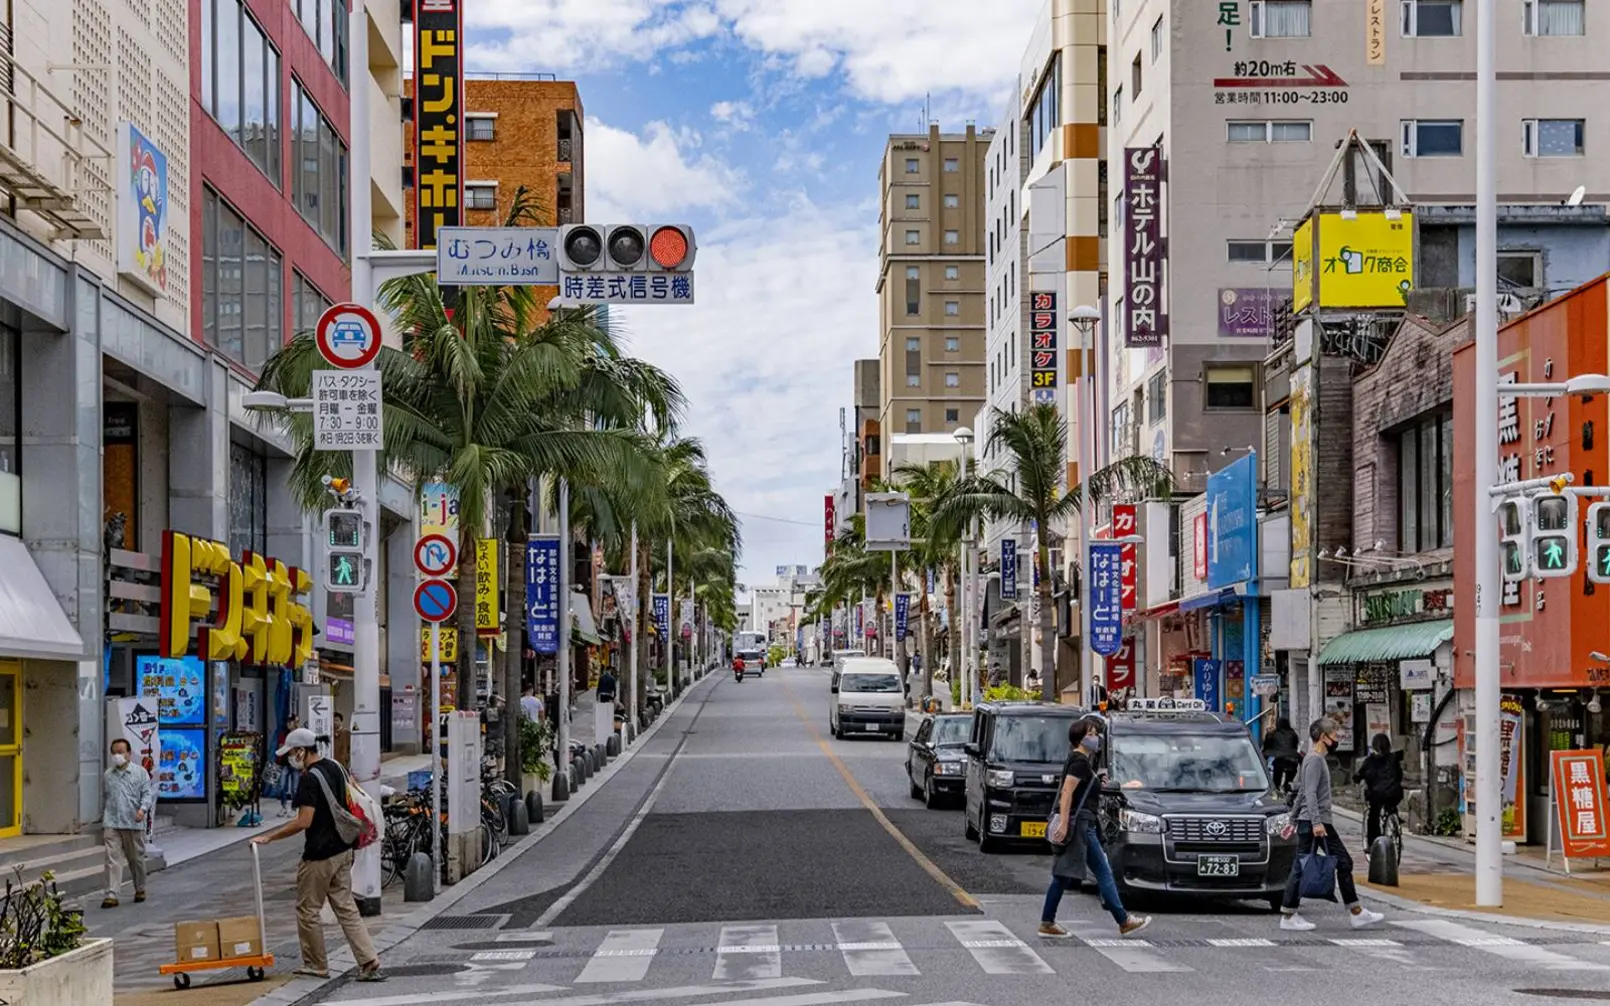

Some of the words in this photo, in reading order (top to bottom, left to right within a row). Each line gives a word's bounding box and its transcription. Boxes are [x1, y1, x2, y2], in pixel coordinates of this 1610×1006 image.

[1234, 60, 1296, 77] 約20m右
[1214, 92, 1261, 104] 営業時間
[448, 238, 550, 260] むつみ橋
[1131, 184, 1155, 331] ホテル山の内
[565, 276, 690, 299] 時差式信号機
[1035, 293, 1052, 367] カラオケ
[1033, 372, 1054, 386] 3F
[319, 389, 377, 401] 許可車を除く
[319, 403, 339, 415] 月曜
[357, 403, 377, 415] 金曜
[320, 416, 342, 429] 7:30
[356, 416, 378, 429] 9:00
[528, 547, 549, 618] なはーと
[1092, 552, 1110, 621] なはーと
[1571, 761, 1597, 834] 黒糖屋
